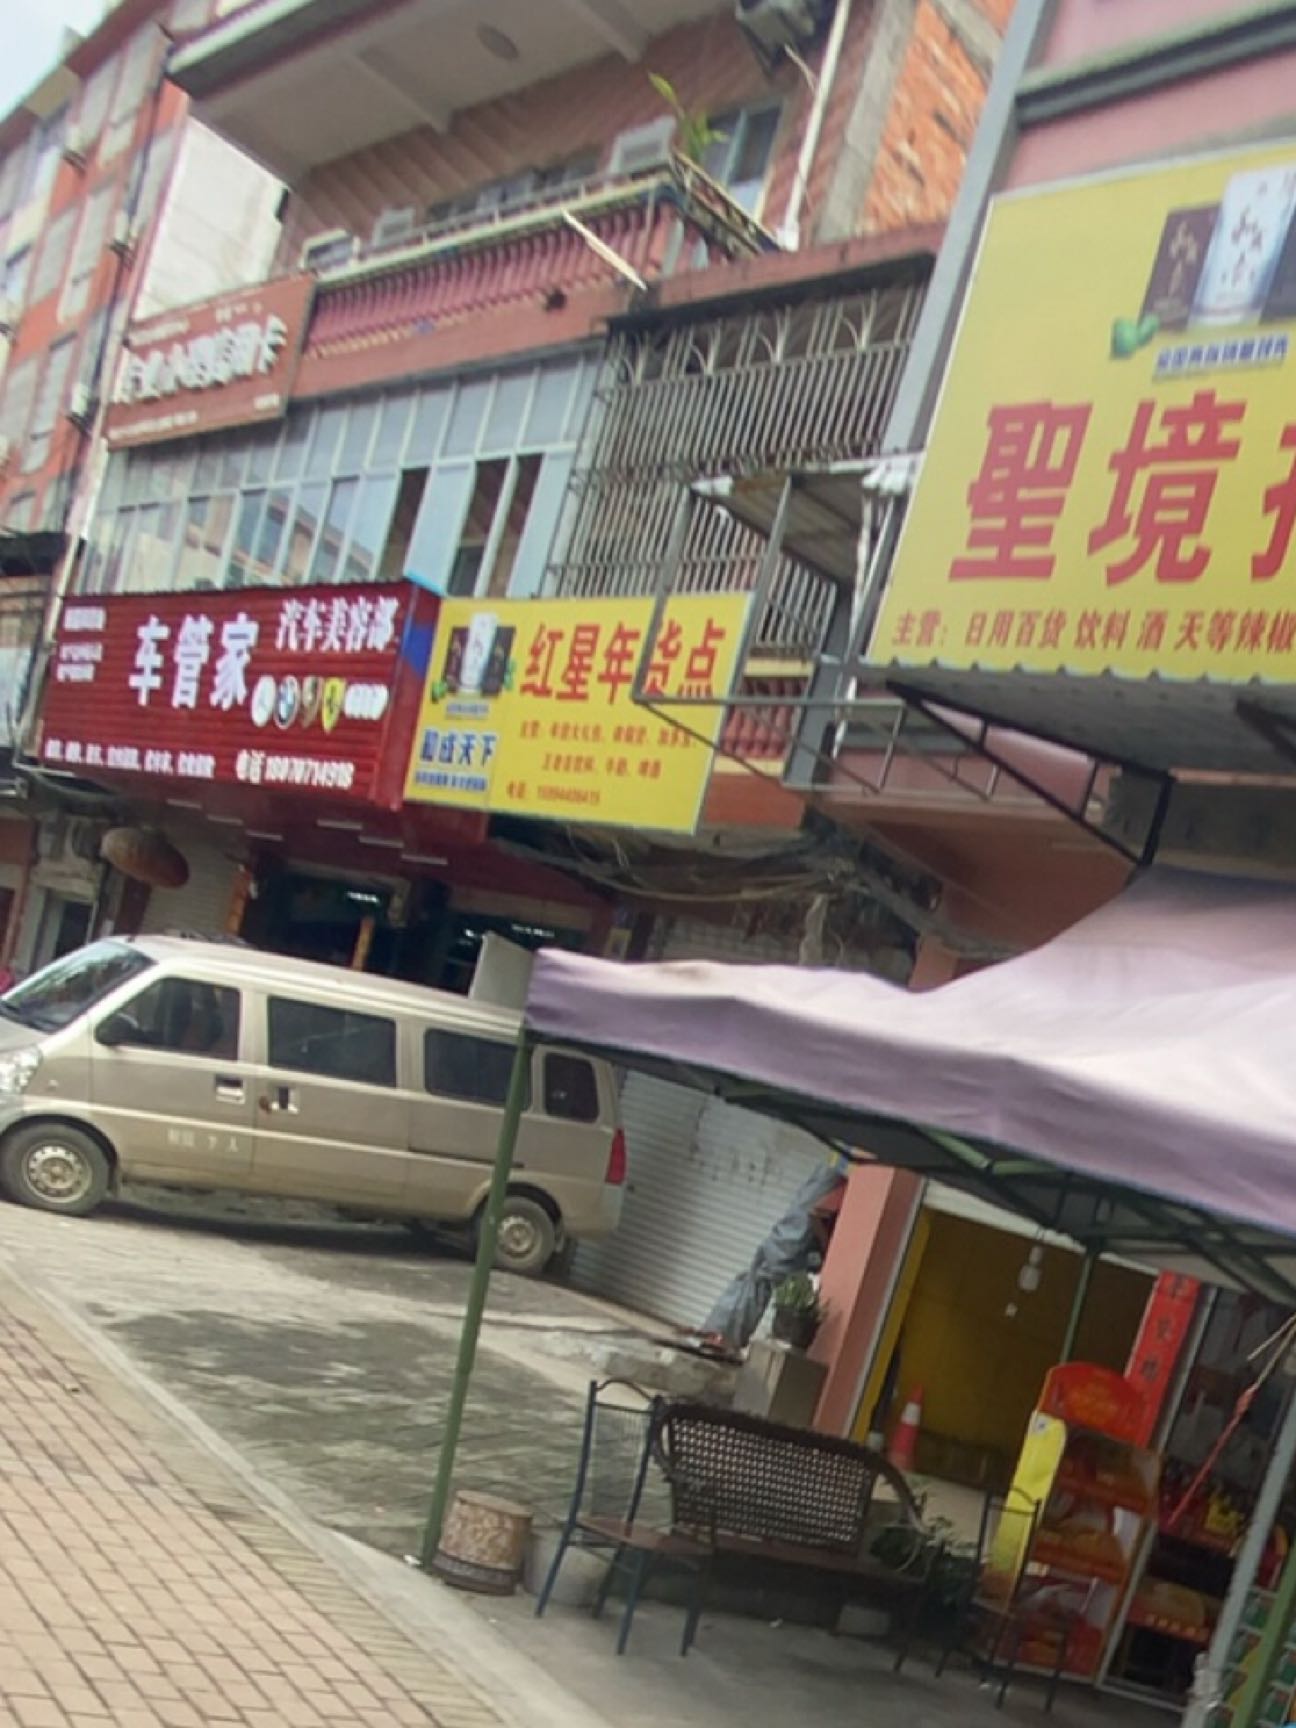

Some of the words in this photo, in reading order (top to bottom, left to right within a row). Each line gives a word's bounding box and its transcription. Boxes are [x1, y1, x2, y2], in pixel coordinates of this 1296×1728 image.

[128, 611, 260, 711] 车管家
[519, 616, 727, 705] 红星年货点
[963, 608, 1067, 650] 日用百货
[1073, 607, 1131, 651] 饮料
[1136, 608, 1169, 652] 酒
